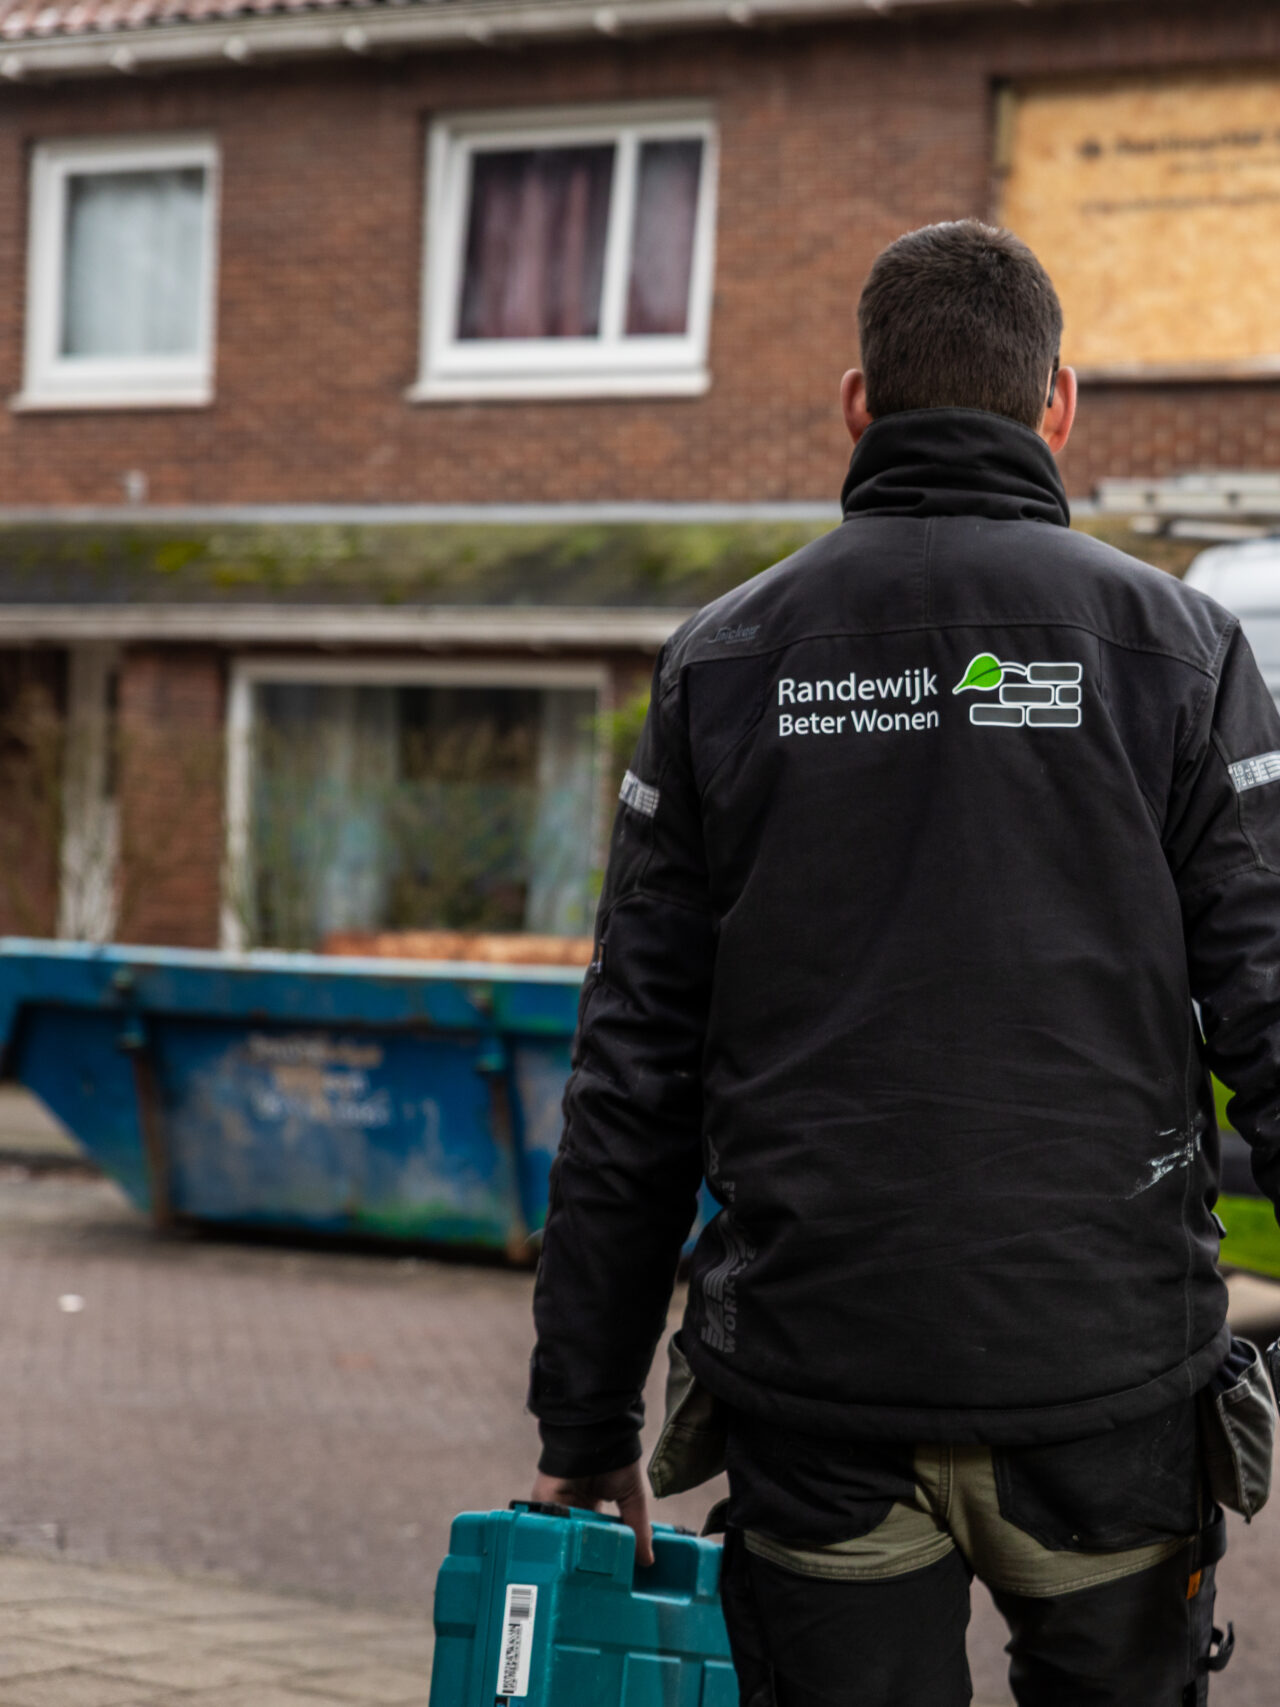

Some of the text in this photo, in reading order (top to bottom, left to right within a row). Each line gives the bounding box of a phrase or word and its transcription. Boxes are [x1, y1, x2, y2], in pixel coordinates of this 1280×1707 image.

[778, 667, 939, 705] Randewijk
[778, 708, 940, 736] Beter Wonen
